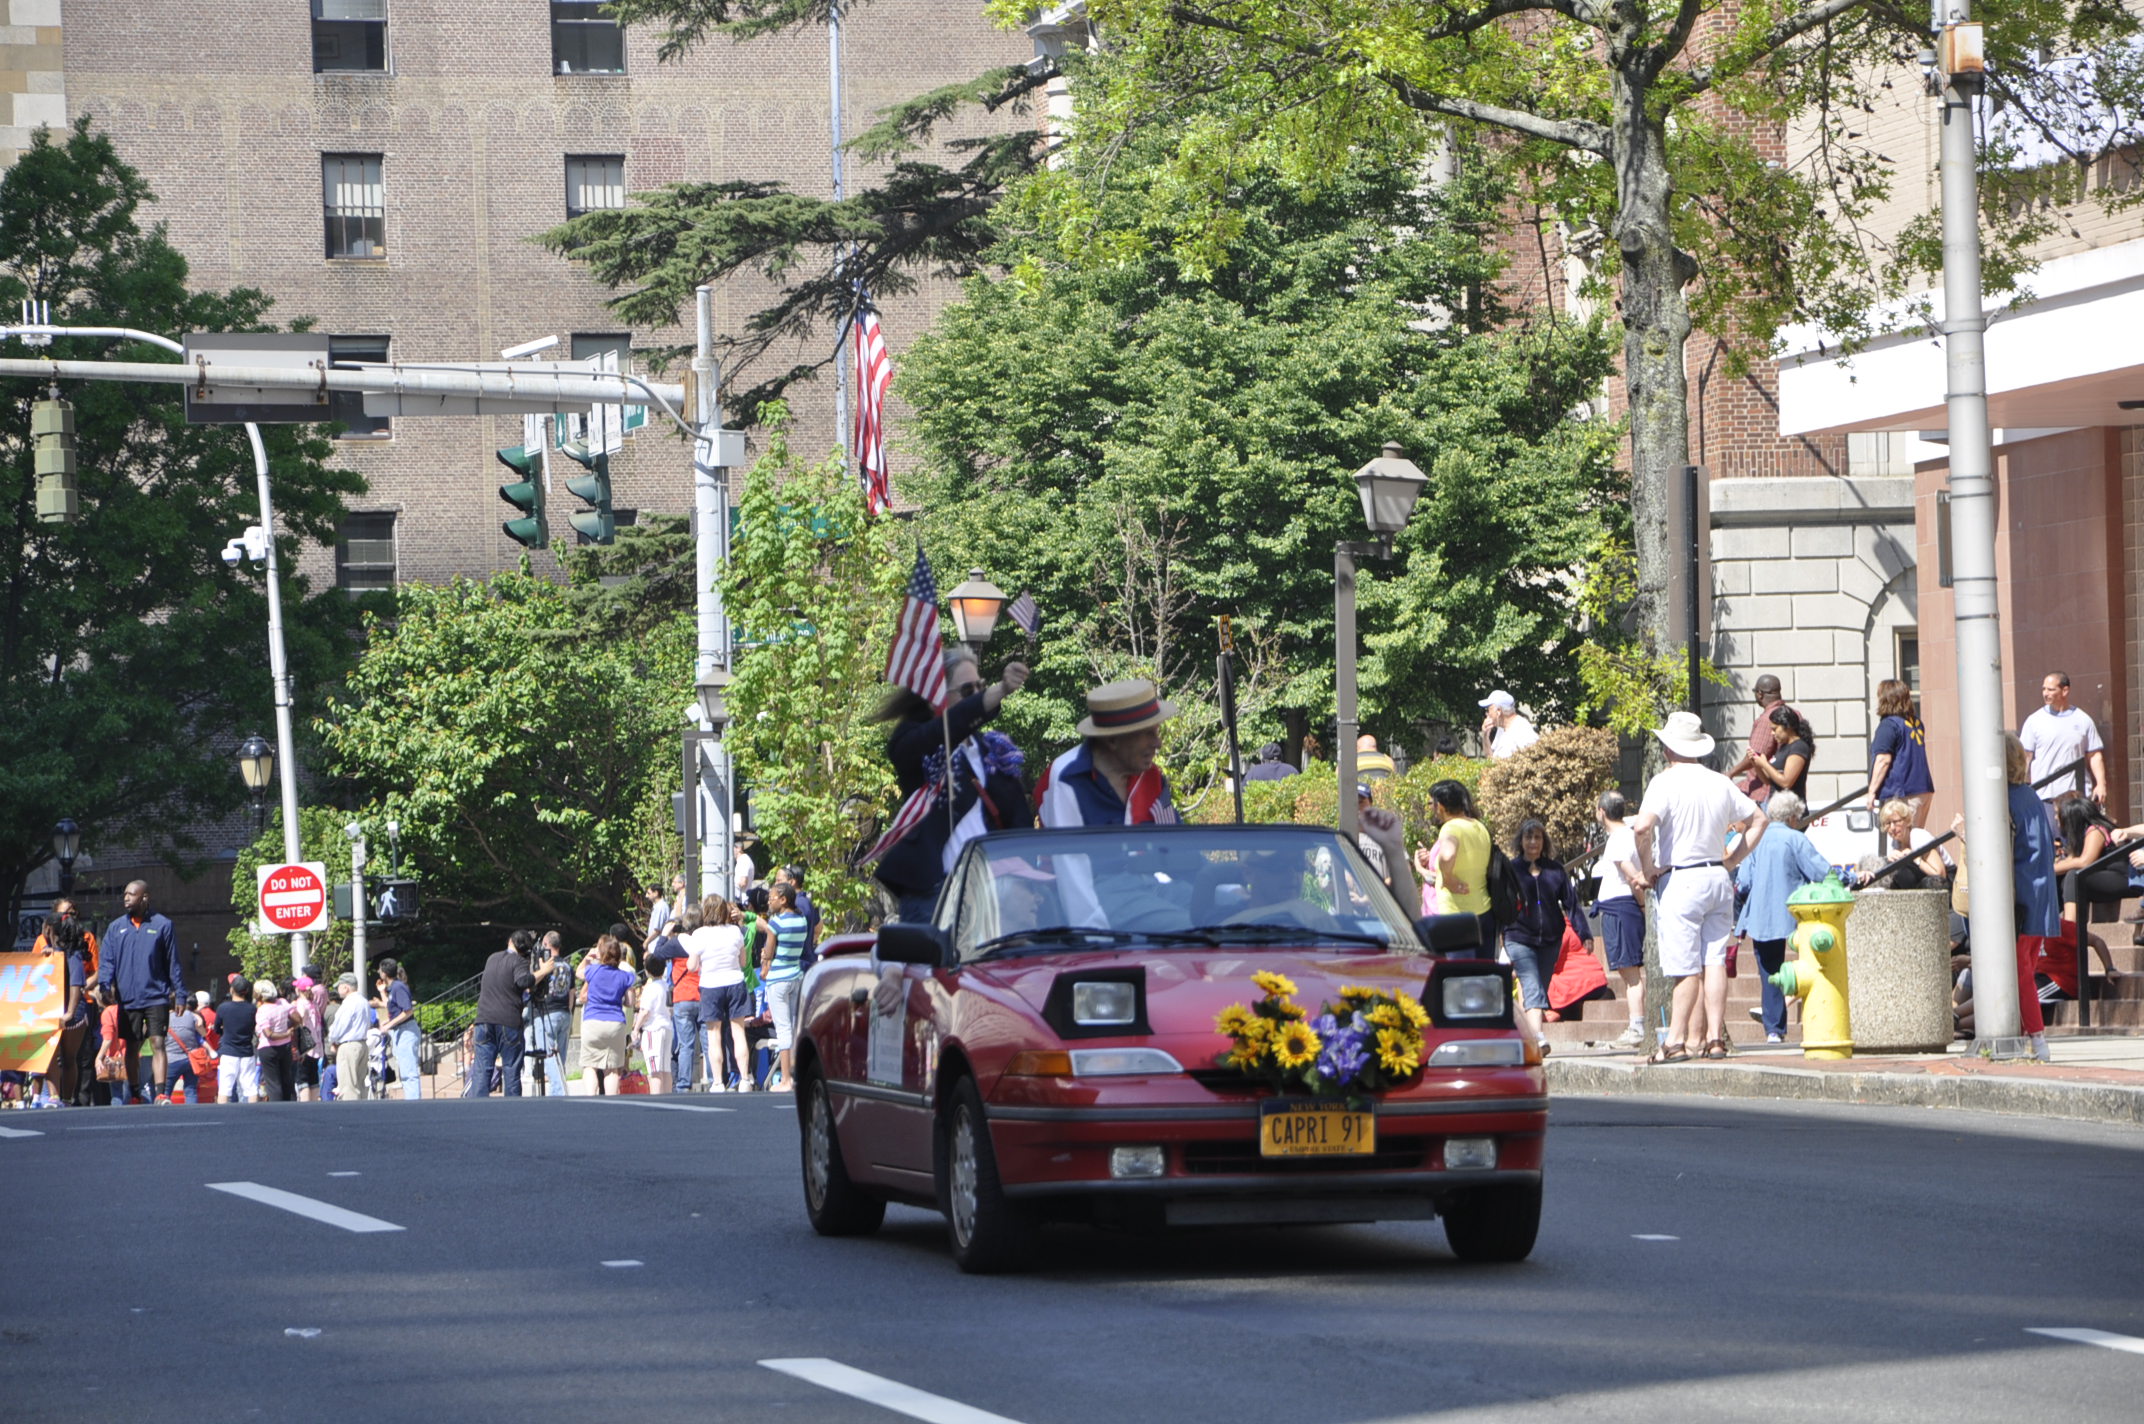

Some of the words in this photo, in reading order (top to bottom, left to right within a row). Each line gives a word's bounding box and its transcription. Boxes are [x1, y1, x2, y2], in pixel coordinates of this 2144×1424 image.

[271, 878, 287, 890] DO
[291, 876, 312, 888] NOT
[276, 905, 311, 918] ENTER
[1272, 1116, 1327, 1144] CAPRI
[1342, 1115, 1362, 1142] 91
